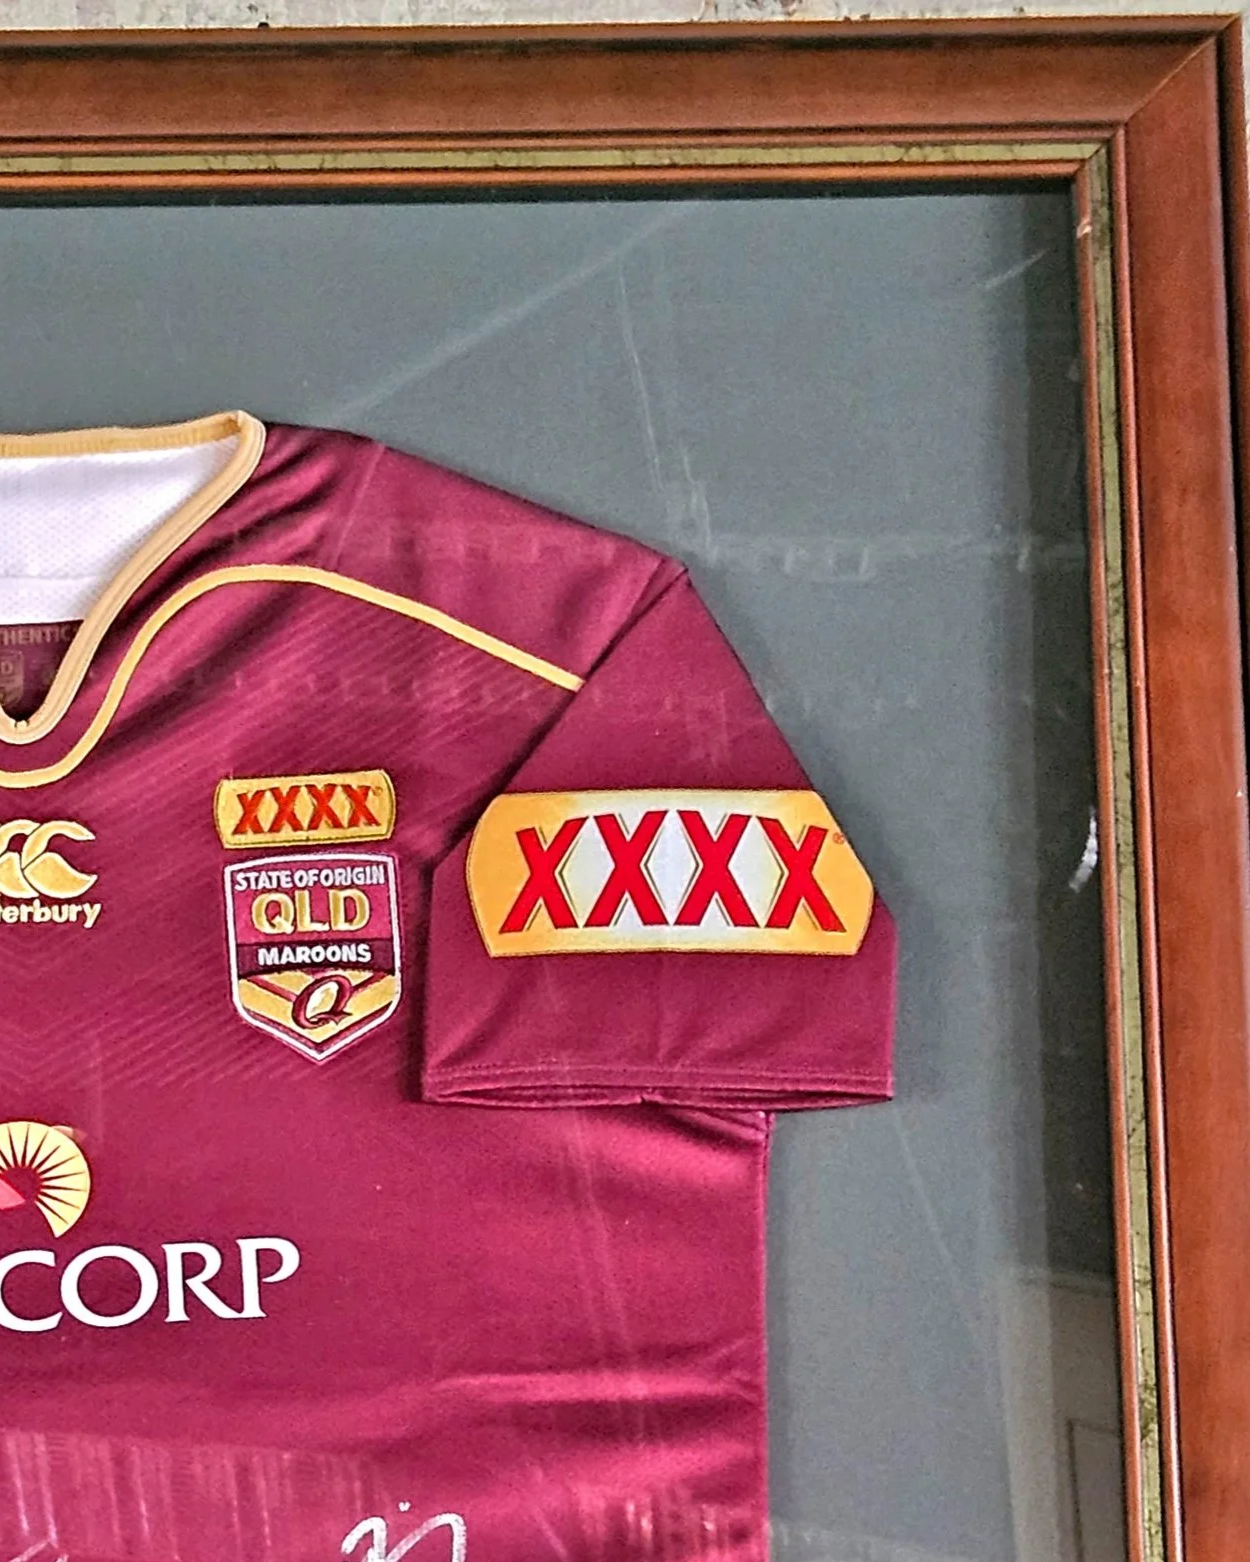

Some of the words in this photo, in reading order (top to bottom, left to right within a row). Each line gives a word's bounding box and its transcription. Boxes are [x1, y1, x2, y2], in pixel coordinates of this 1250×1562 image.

[231, 783, 382, 835] XXXX
[235, 871, 294, 891] STATE
[293, 869, 320, 888] OF
[318, 865, 385, 887] ORIGIN
[499, 809, 845, 935] XXXX
[251, 889, 370, 936] QLD
[257, 944, 372, 966] MAROONS
